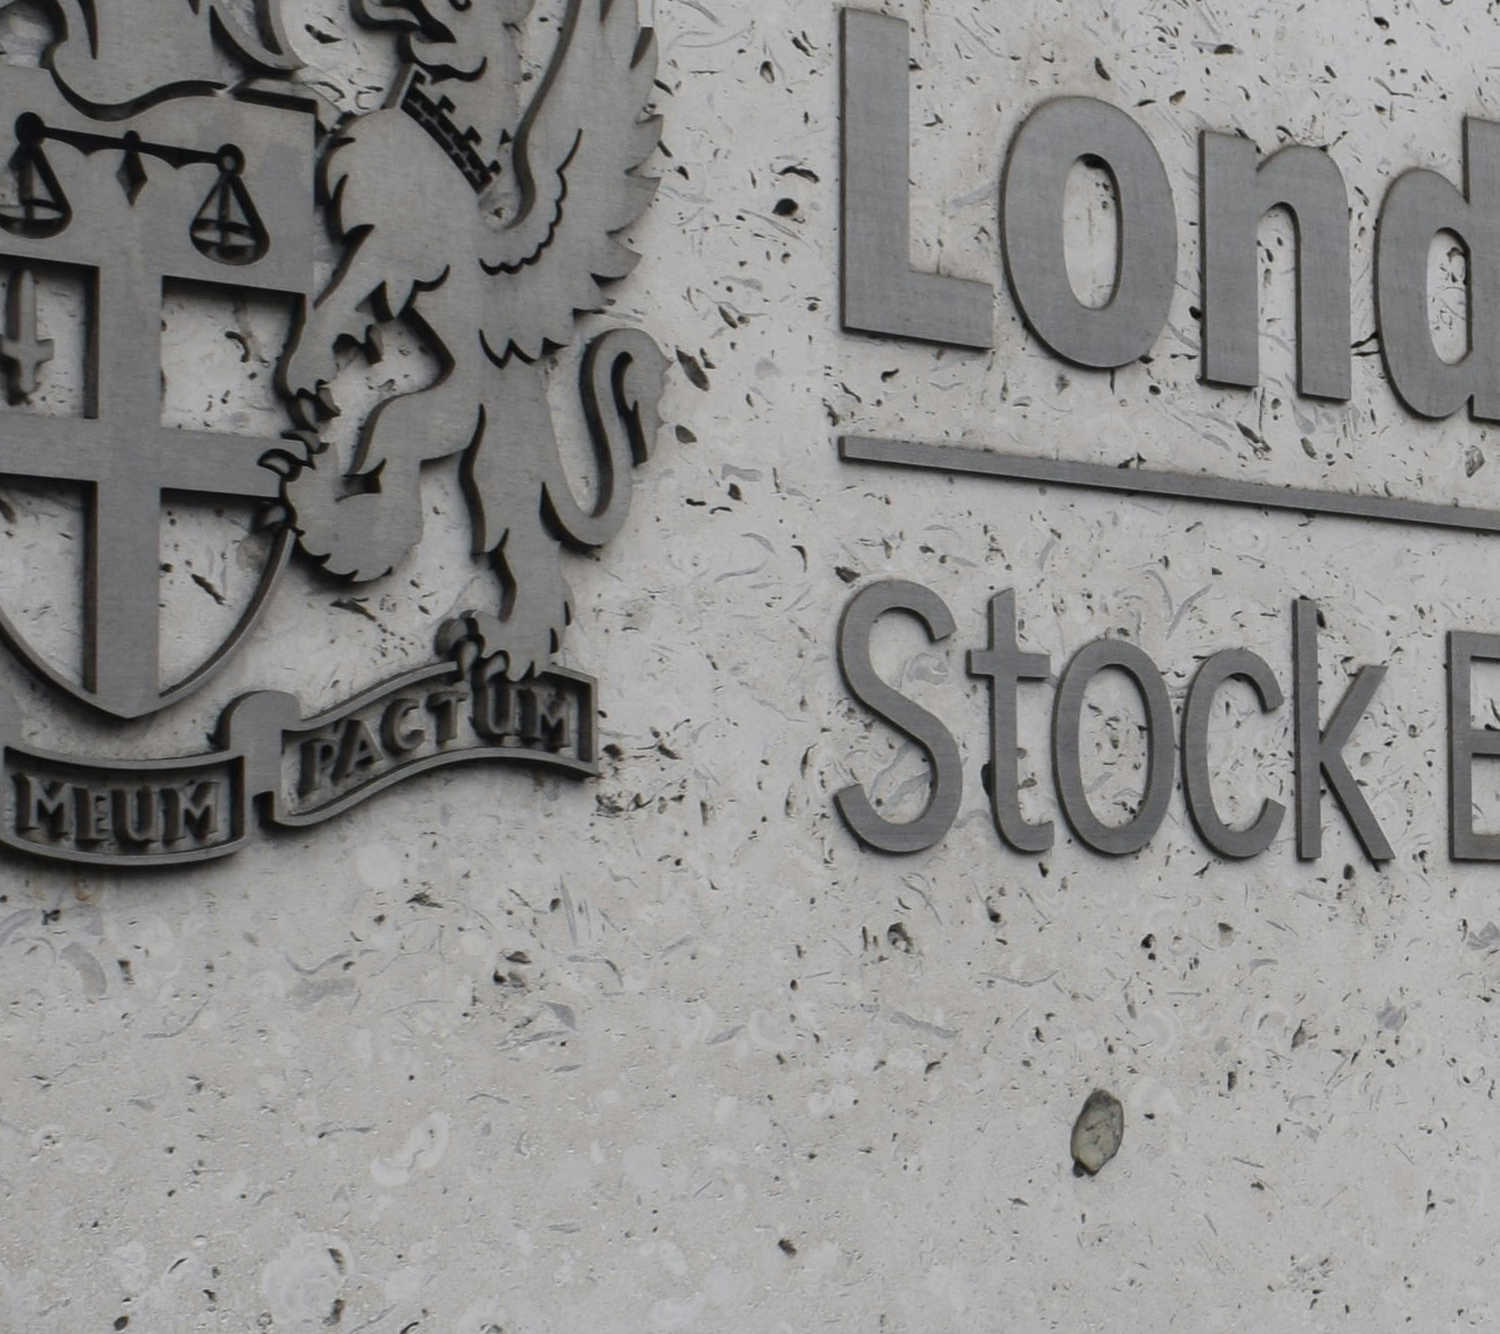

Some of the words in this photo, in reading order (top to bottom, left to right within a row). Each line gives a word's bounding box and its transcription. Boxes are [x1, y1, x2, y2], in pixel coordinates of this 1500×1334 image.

[11, 772, 222, 847] MEUM
[297, 679, 573, 799] PACTUM
[833, 579, 1395, 864] Stock
